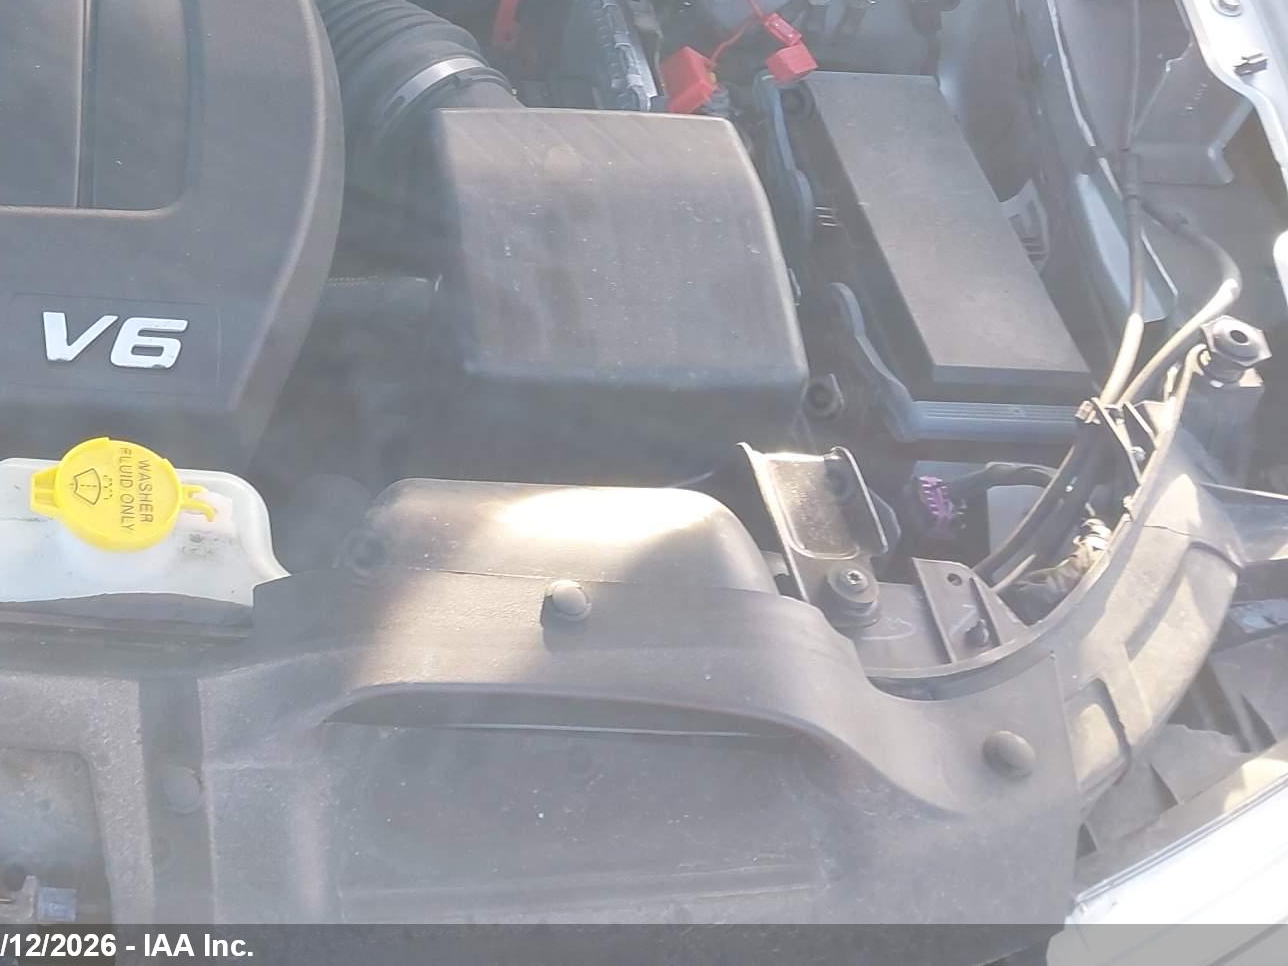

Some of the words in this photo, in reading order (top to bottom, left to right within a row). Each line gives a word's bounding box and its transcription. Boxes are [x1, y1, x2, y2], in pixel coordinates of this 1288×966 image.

[42, 311, 189, 369] V6
[119, 447, 134, 489] FLUID
[137, 459, 154, 523] WASHER
[119, 493, 137, 531] ONLY
